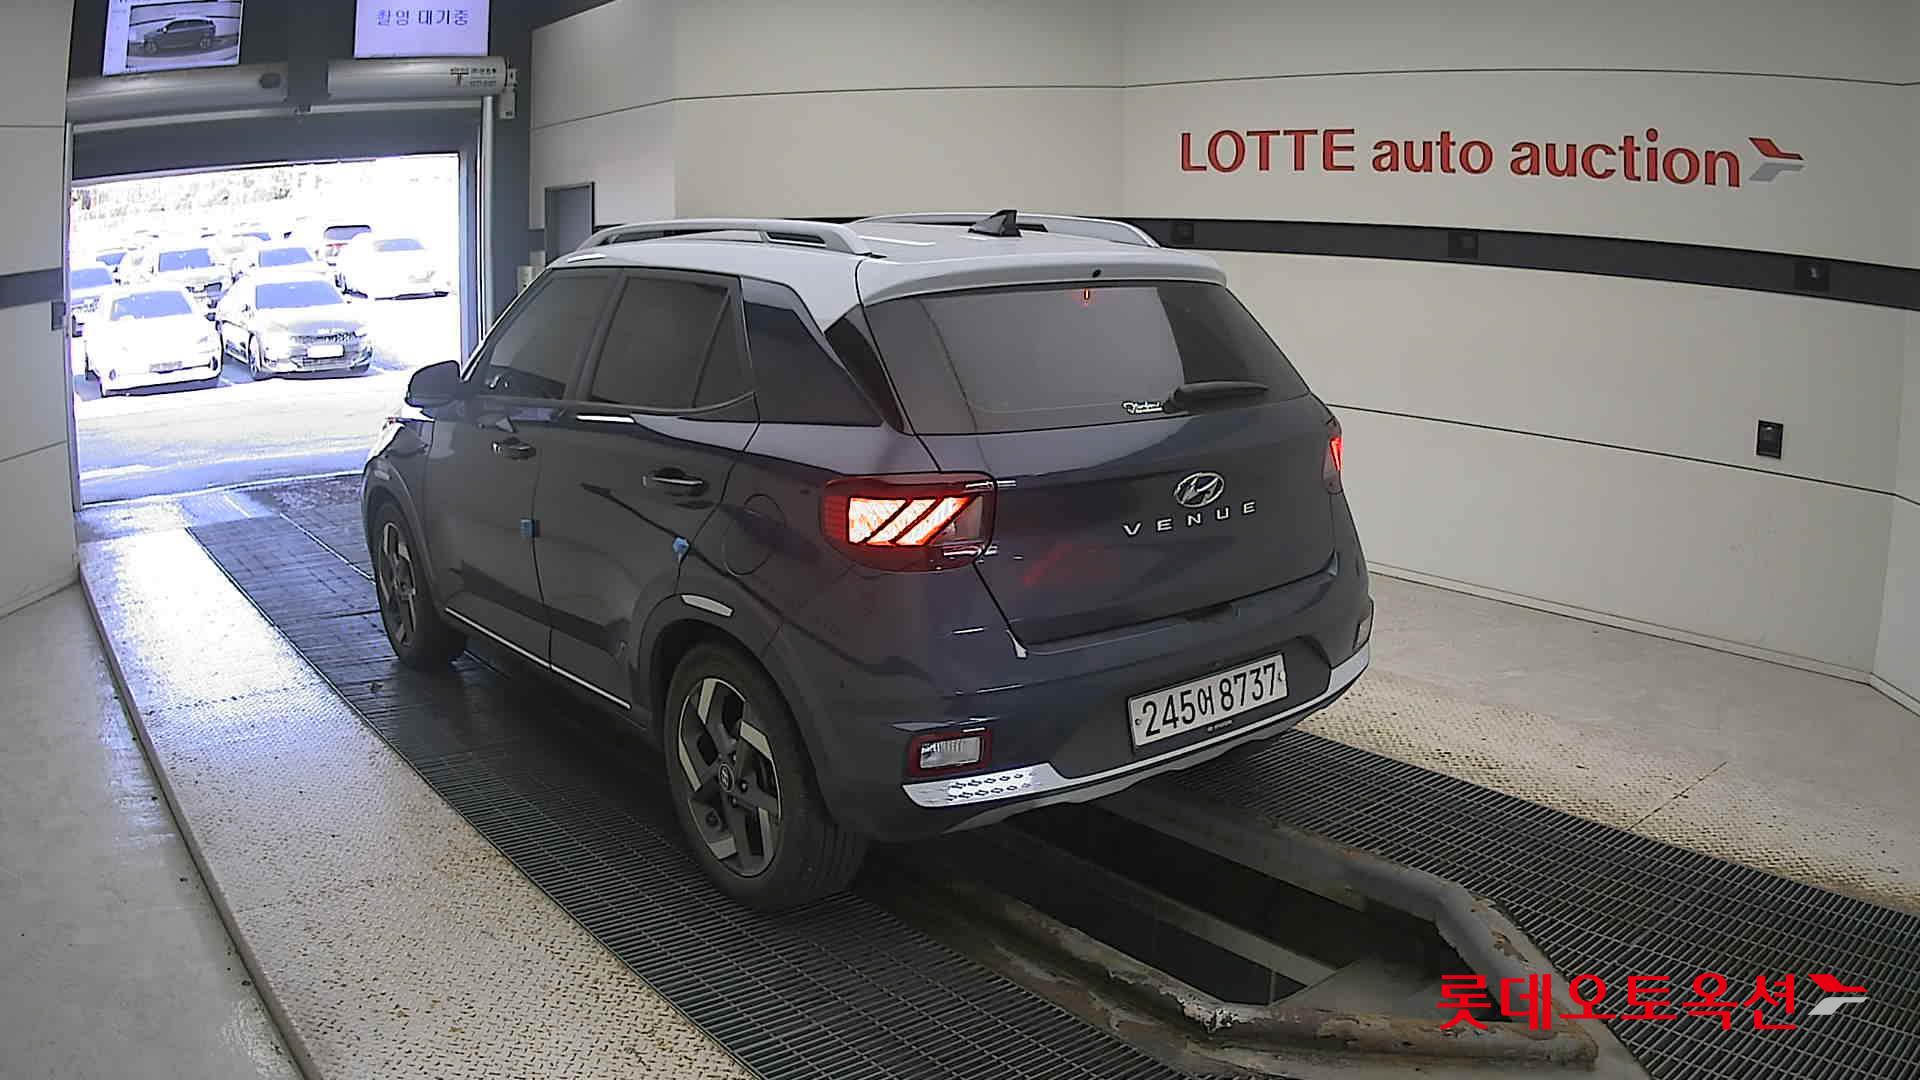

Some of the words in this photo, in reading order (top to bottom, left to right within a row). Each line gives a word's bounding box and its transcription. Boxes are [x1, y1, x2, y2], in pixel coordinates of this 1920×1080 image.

[418, 9, 468, 26] 대기중
[1180, 128, 1355, 173] LOTTE
[1371, 131, 1494, 174] auto
[1510, 128, 1741, 188] auction
[1123, 501, 1256, 535] VENUE
[1219, 662, 1276, 711] 8737
